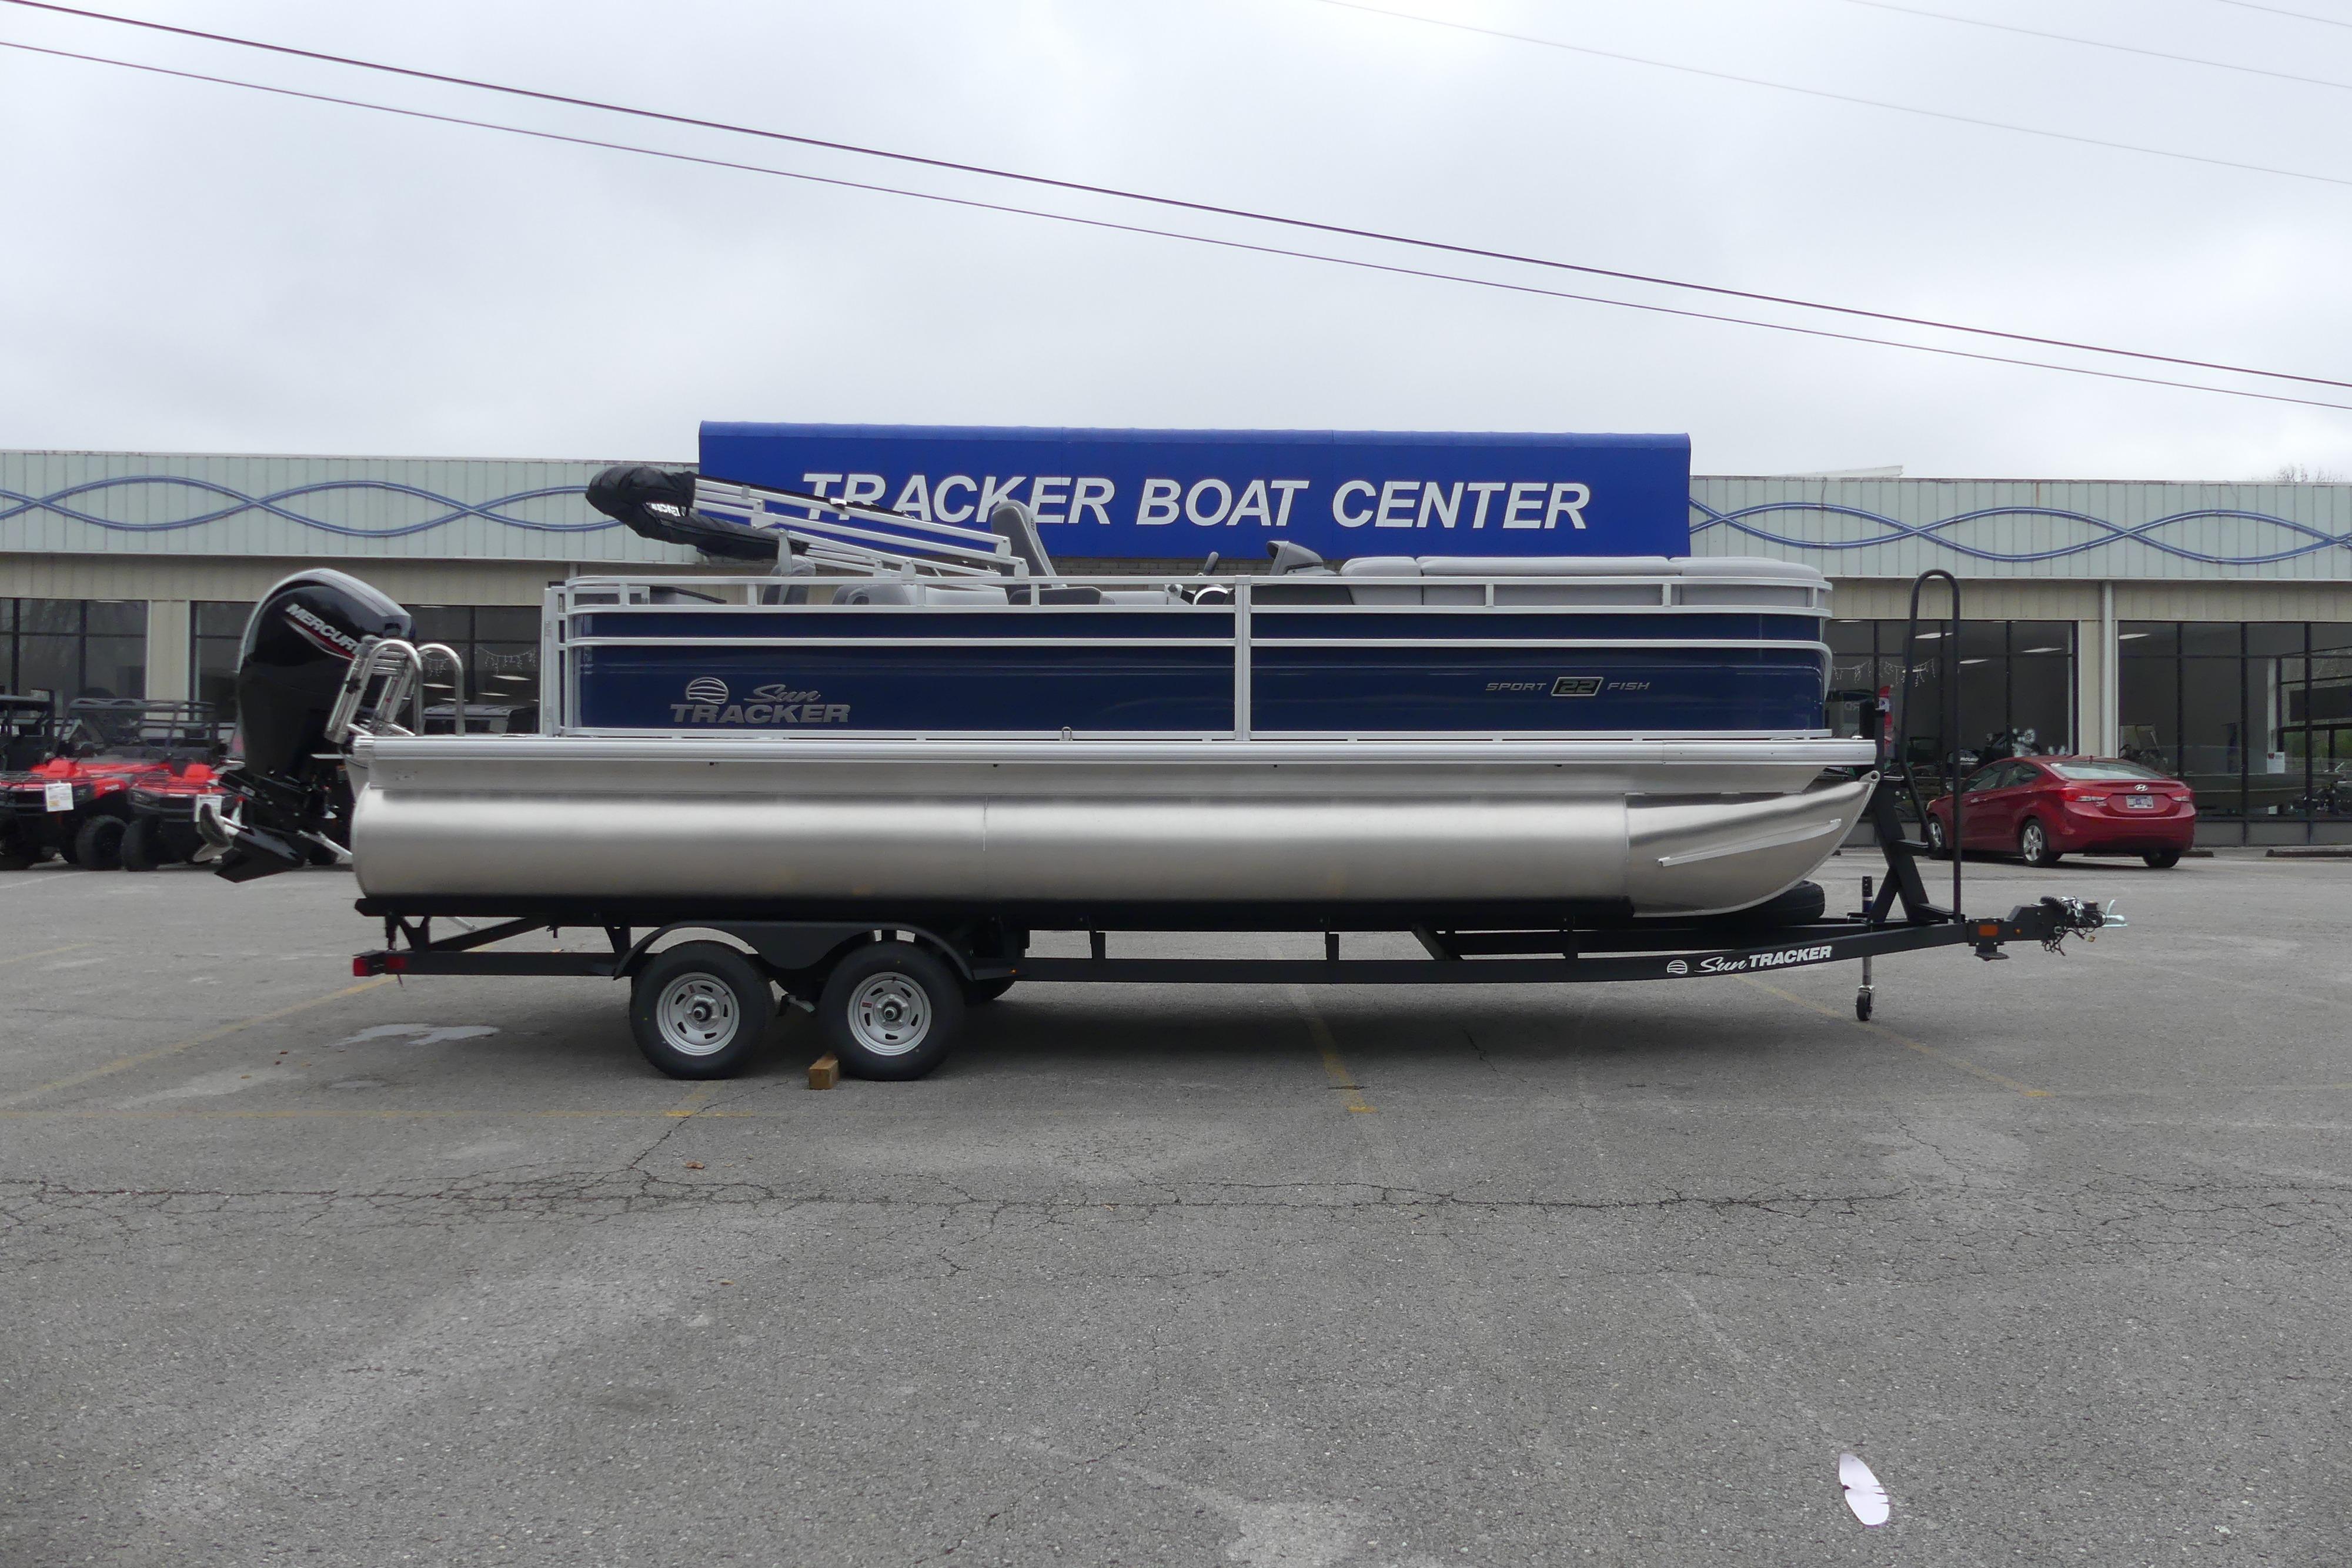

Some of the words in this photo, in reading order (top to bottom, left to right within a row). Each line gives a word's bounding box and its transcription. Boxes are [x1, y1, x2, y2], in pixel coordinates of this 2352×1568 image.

[803, 473, 1115, 524] TRACKER
[1137, 479, 1309, 526] BOAT
[1332, 480, 1591, 529] CENTER
[285, 603, 360, 653] MERCUR
[744, 684, 821, 703] Sun
[1485, 683, 1546, 691] SPORT
[1559, 680, 1596, 694] 22
[1606, 682, 1651, 690] FISH
[670, 704, 851, 724] TRACKER
[1693, 957, 1747, 972] Sun
[1749, 945, 1832, 968] TRACKER
